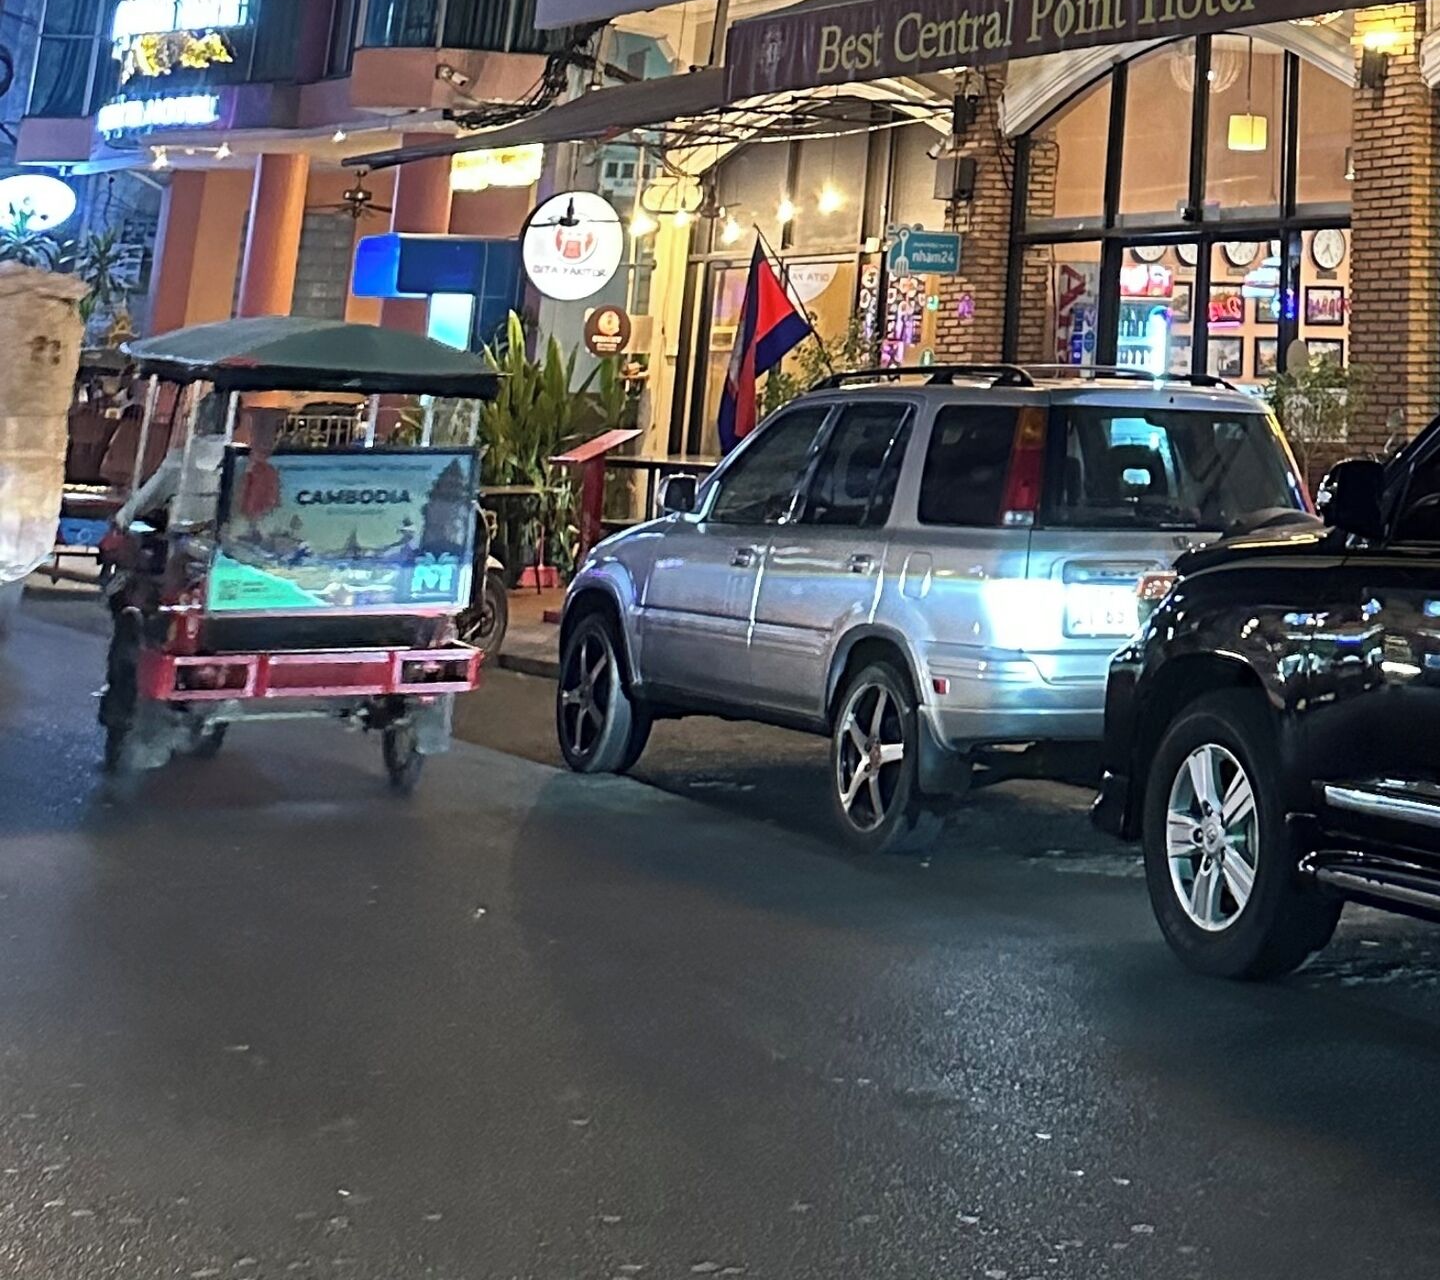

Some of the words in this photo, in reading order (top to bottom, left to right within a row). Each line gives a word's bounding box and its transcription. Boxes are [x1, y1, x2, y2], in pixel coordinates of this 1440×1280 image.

[816, 24, 884, 74] Best
[911, 249, 955, 265] nham24
[296, 489, 410, 506] CAMBODIA
